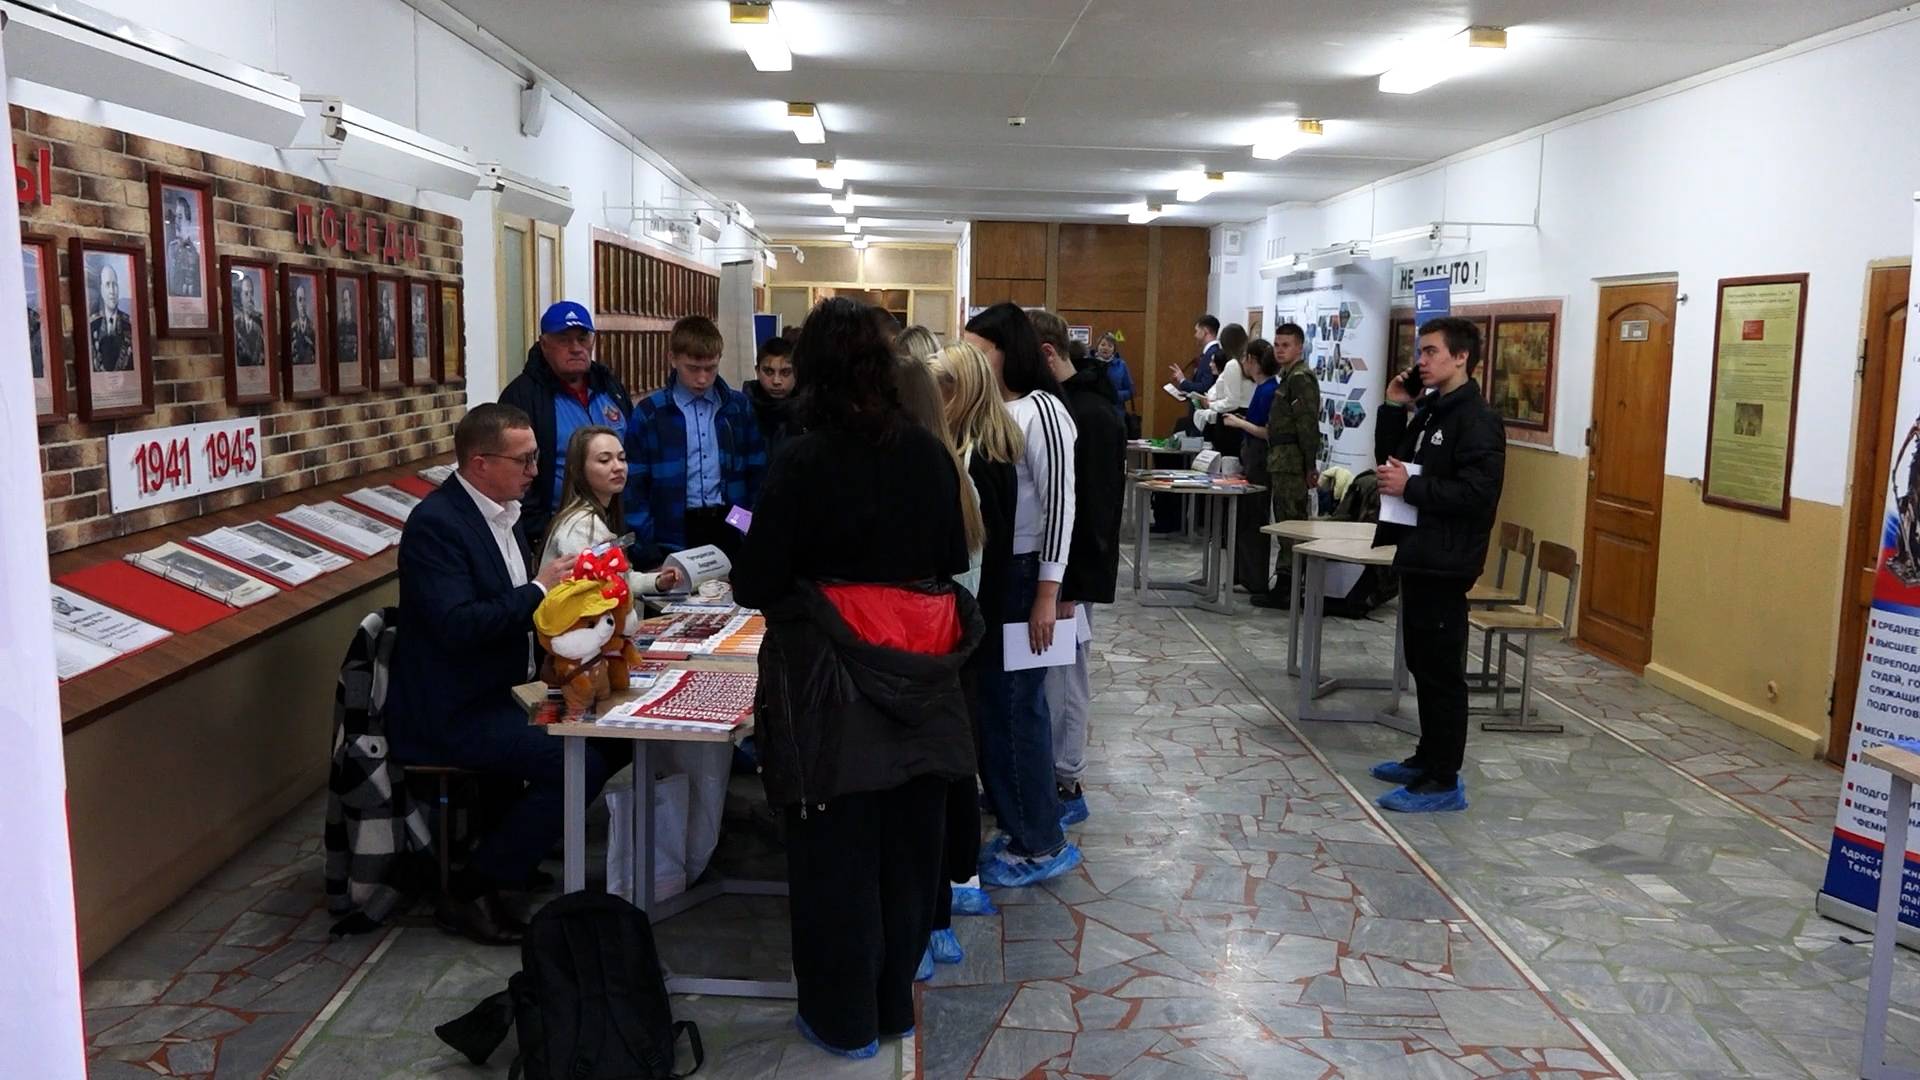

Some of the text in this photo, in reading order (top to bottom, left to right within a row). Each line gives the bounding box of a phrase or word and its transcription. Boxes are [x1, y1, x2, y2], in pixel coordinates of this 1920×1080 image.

[296, 202, 418, 265] ПОБЕДЫ
[1400, 269, 1415, 290] НЕ
[134, 427, 256, 494] 1941 1945
[1875, 638, 1917, 655] ВЫСШЕЕ
[1871, 669, 1904, 687] СУДЕЙ,
[1867, 698, 1920, 719] ПОДГОТОВ
[1864, 725, 1895, 740] МЕСТА
[1841, 845, 1875, 864] Адрес:
[1848, 860, 1881, 880] Телеф
